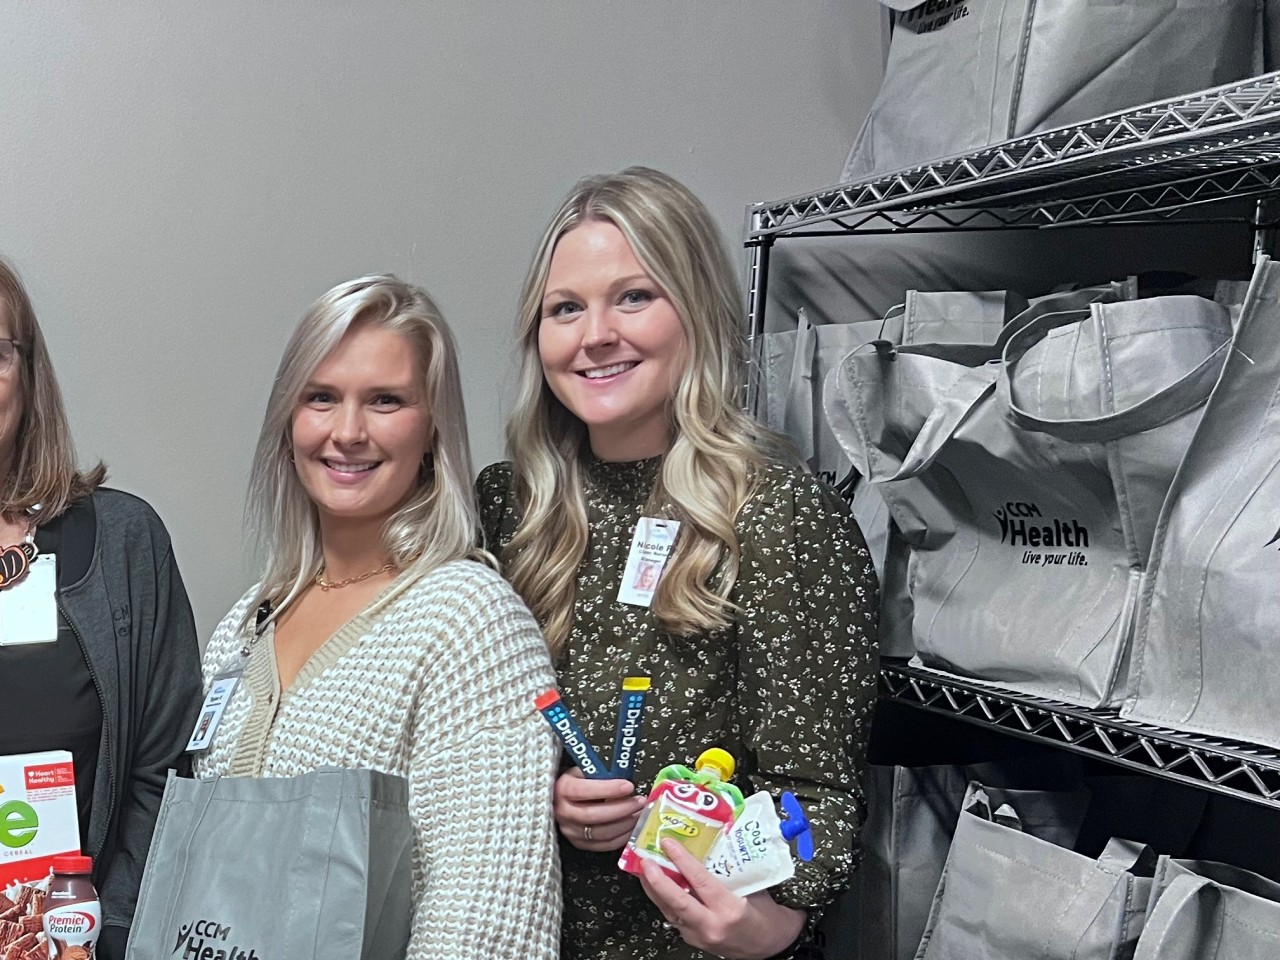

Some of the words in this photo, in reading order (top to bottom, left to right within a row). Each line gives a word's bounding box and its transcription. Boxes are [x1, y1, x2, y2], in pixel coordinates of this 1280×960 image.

[1006, 502, 1042, 518] CCM
[1009, 518, 1089, 548] Health
[637, 541, 664, 551] Nicole
[1022, 550, 1041, 564] live
[1041, 554, 1067, 568] your
[1067, 551, 1088, 566] life.
[555, 718, 597, 775] DripDrop
[616, 709, 642, 769] DripDrop
[28, 776, 55, 784] Healthy
[3, 848, 34, 858] CEREAL
[734, 826, 751, 864] YOGURTZ
[48, 914, 86, 925] Premier
[50, 924, 83, 933] Protein
[195, 919, 231, 941] CCM
